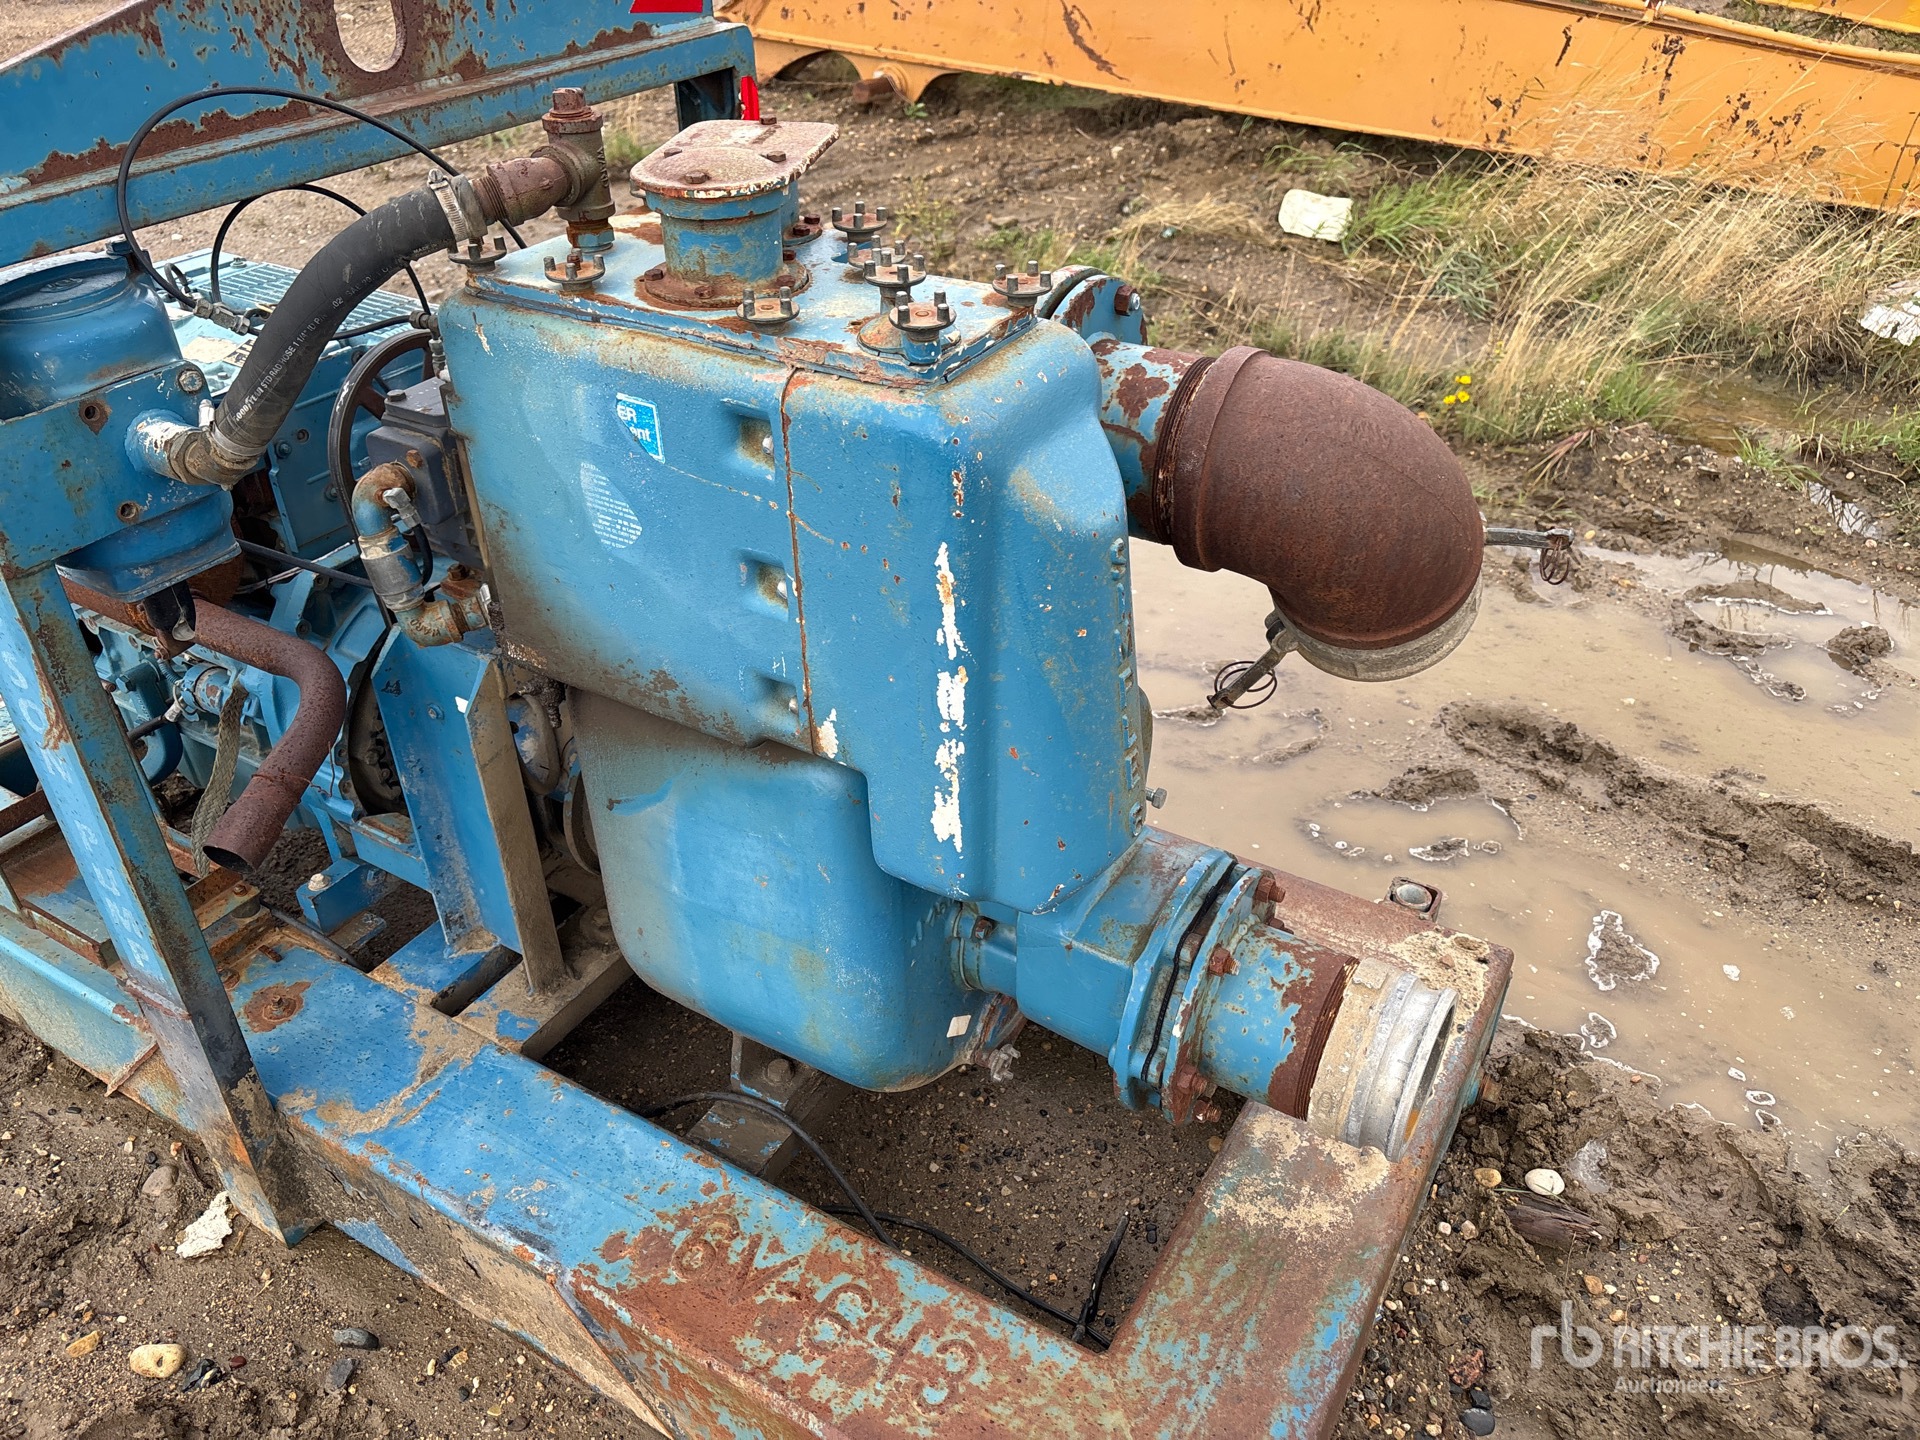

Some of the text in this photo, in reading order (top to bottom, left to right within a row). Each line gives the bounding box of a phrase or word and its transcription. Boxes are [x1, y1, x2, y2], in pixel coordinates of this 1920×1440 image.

[260, 374, 273, 389] STD
[269, 363, 282, 379] RAD
[280, 345, 296, 365] HOSE
[76, 818, 149, 968] PUMP
